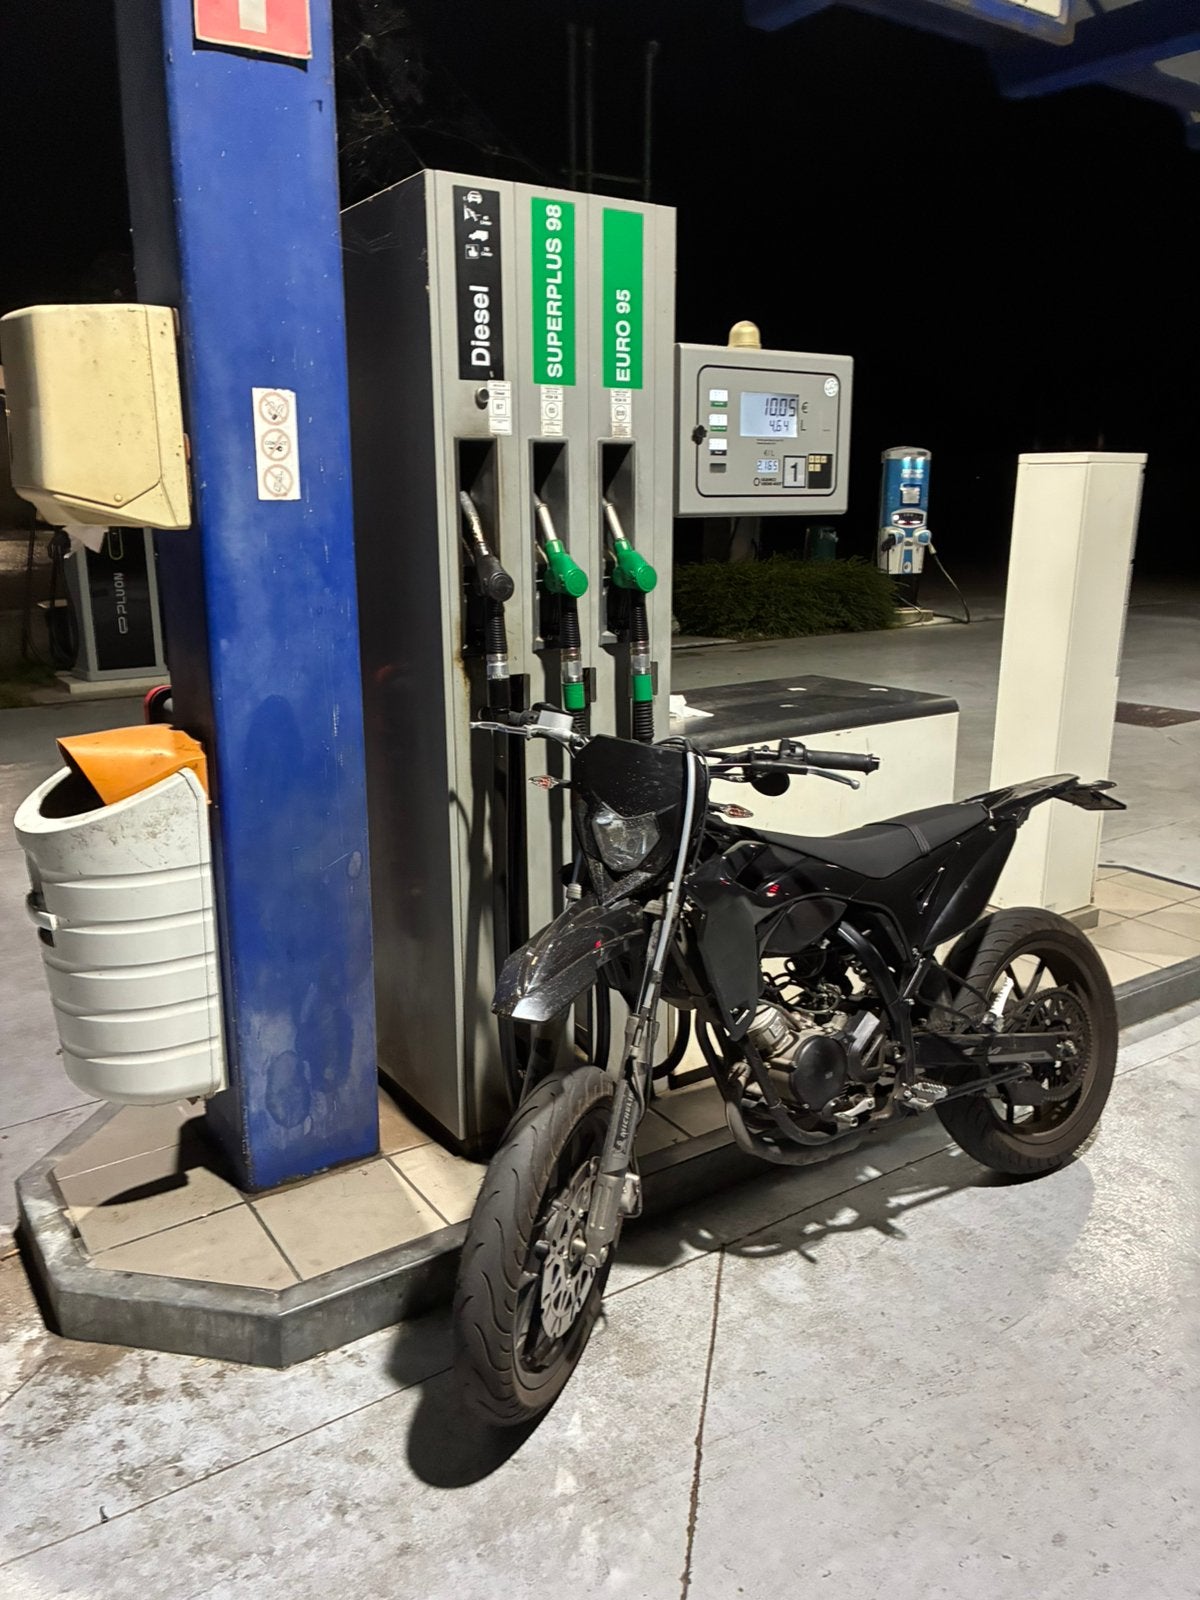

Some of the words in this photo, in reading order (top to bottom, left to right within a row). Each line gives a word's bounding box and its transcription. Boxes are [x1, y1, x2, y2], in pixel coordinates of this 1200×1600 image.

[545, 204, 563, 231] 98
[546, 237, 563, 378] SUPERPLUS
[615, 289, 631, 314] 95
[469, 285, 491, 366] Diesel
[615, 319, 631, 382] EURO
[801, 401, 809, 414] €
[800, 419, 807, 431] L
[790, 462, 798, 482] 1
[113, 572, 128, 615] PLUON
